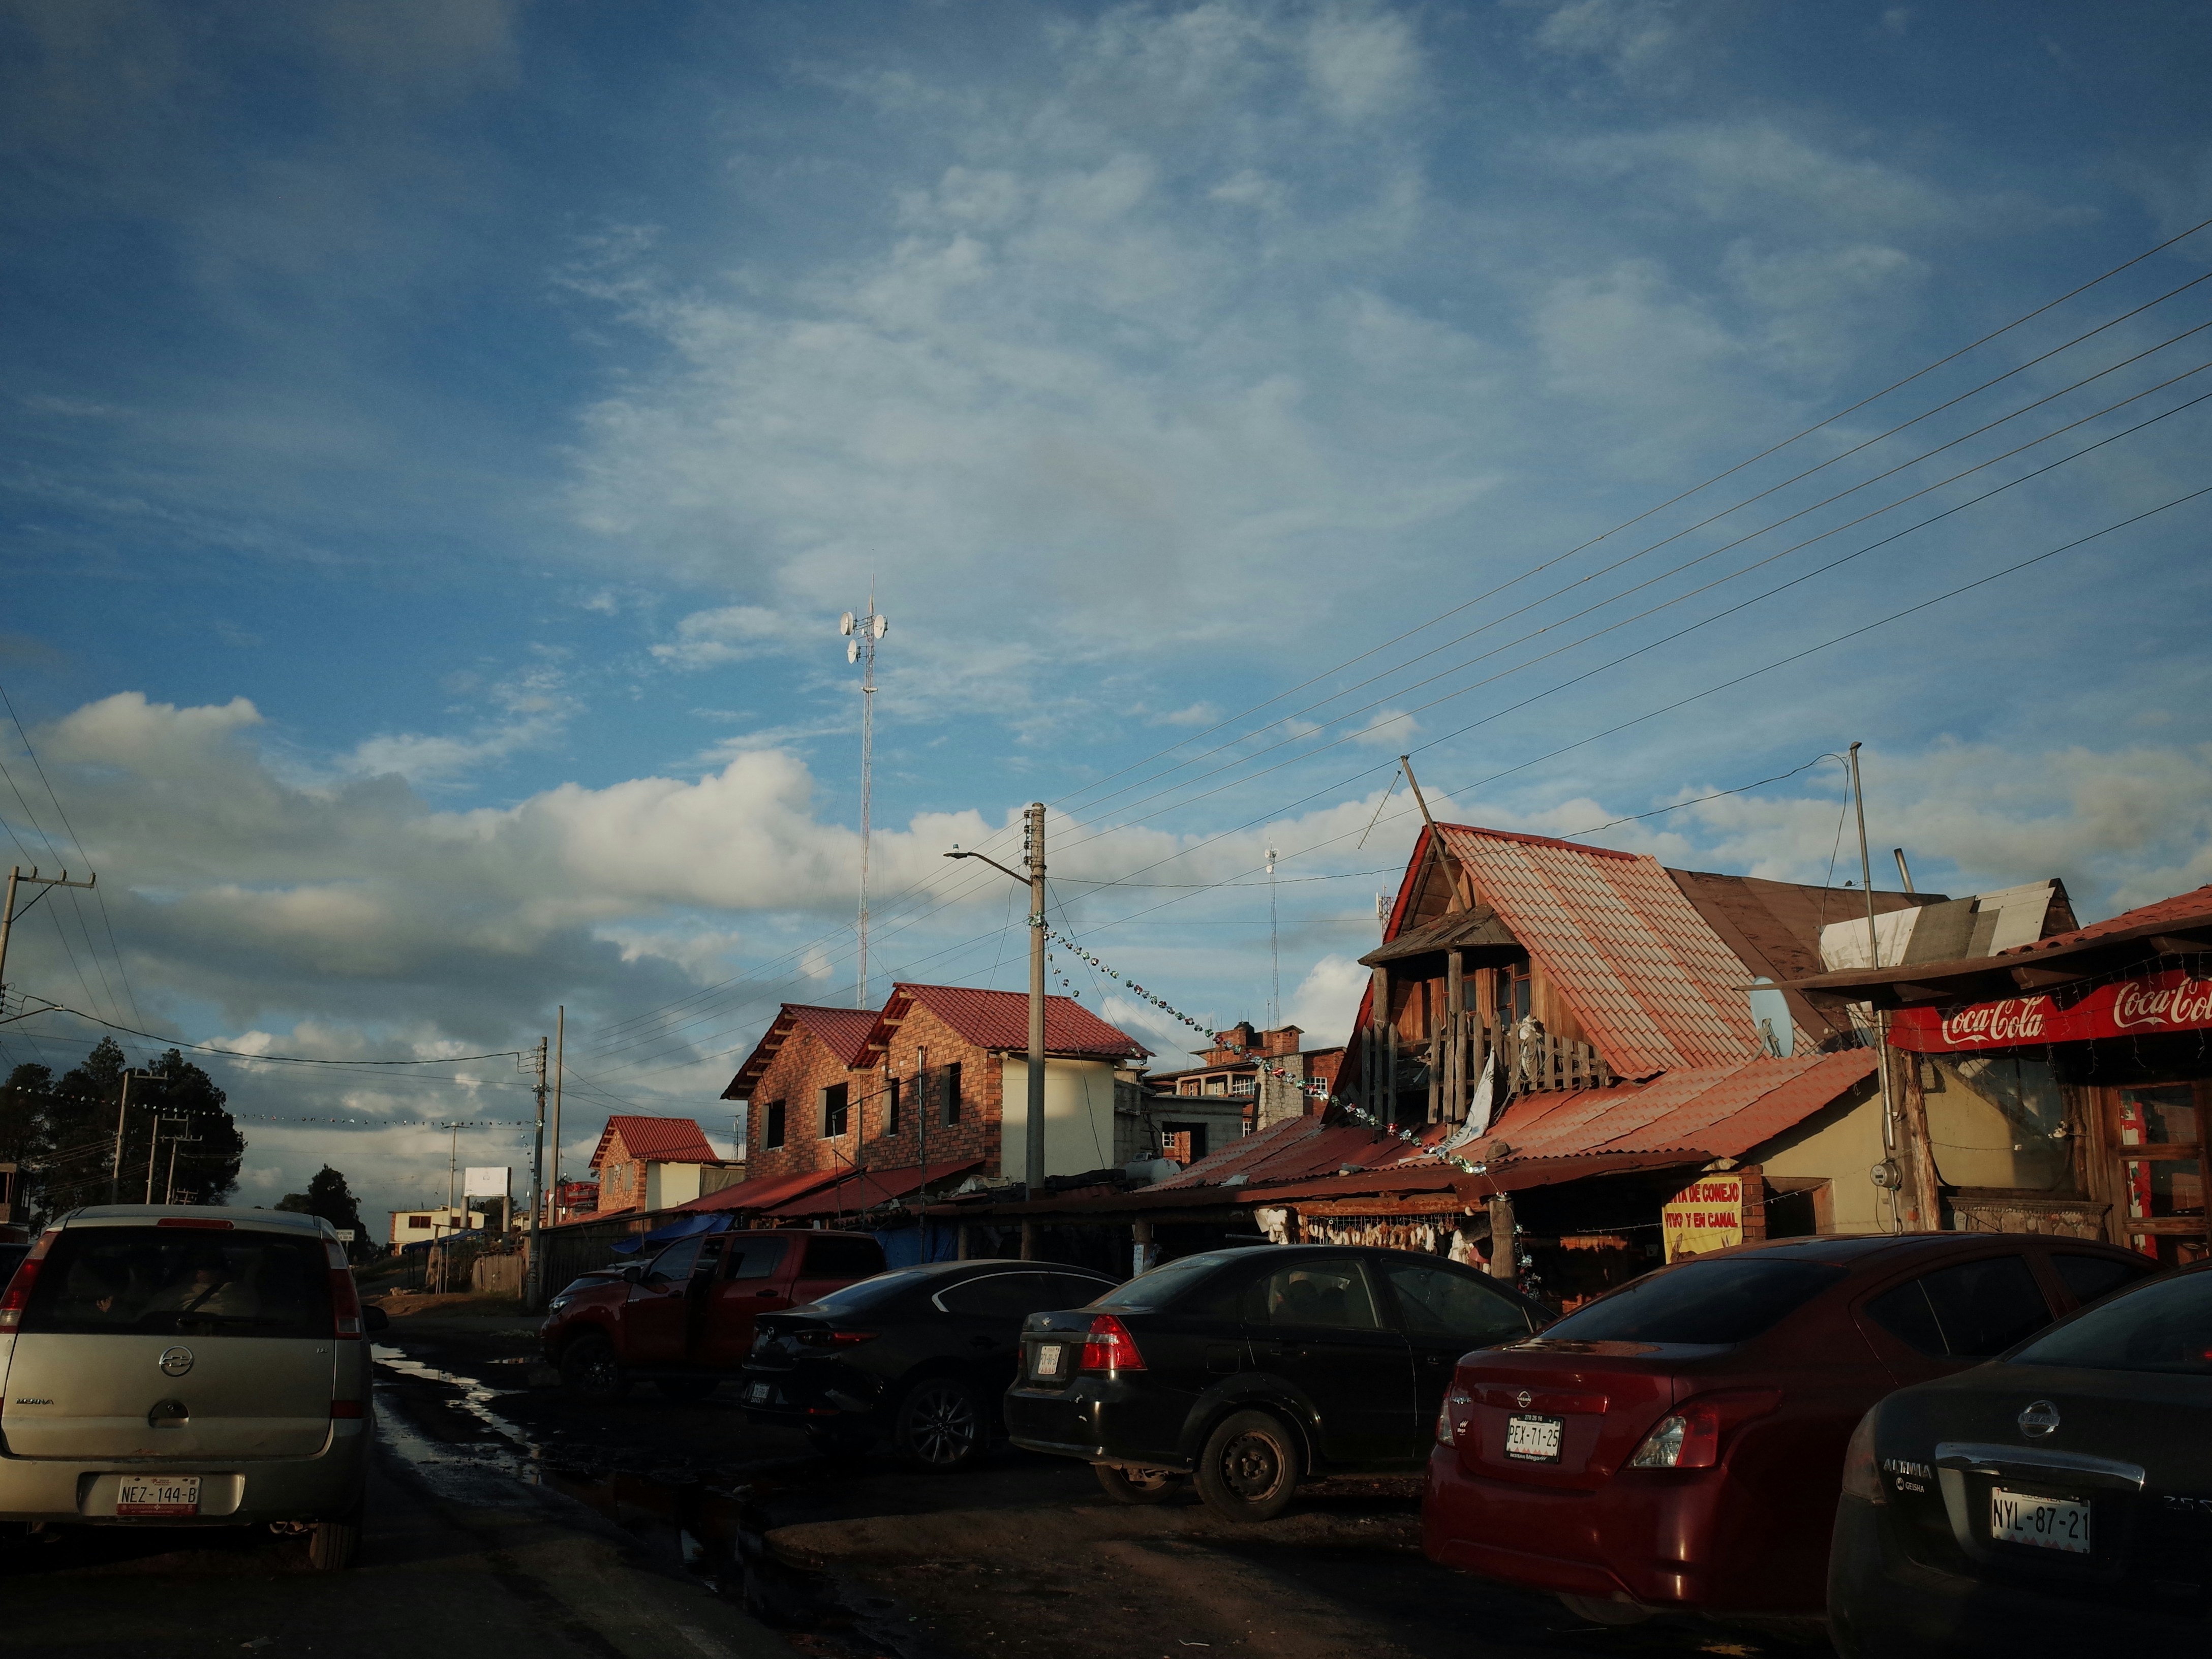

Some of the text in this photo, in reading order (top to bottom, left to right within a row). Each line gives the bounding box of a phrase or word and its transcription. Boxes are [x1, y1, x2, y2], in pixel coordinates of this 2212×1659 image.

[2113, 977, 2212, 1028] Coca-Col
[1942, 995, 2046, 1044] Coca-Cola
[1689, 1184, 1701, 1203] DE
[1702, 1183, 1739, 1203] CONEJO
[1665, 1212, 1738, 1228] VIVO Y EN CANAL
[2020, 1415, 2054, 1424] NISSAN
[1508, 1425, 1559, 1448] PEX-71-25
[121, 1487, 196, 1502] NEZ-144-B
[1905, 1481, 1925, 1493] GEISHA
[1993, 1499, 2088, 1540] NYL-87-21
